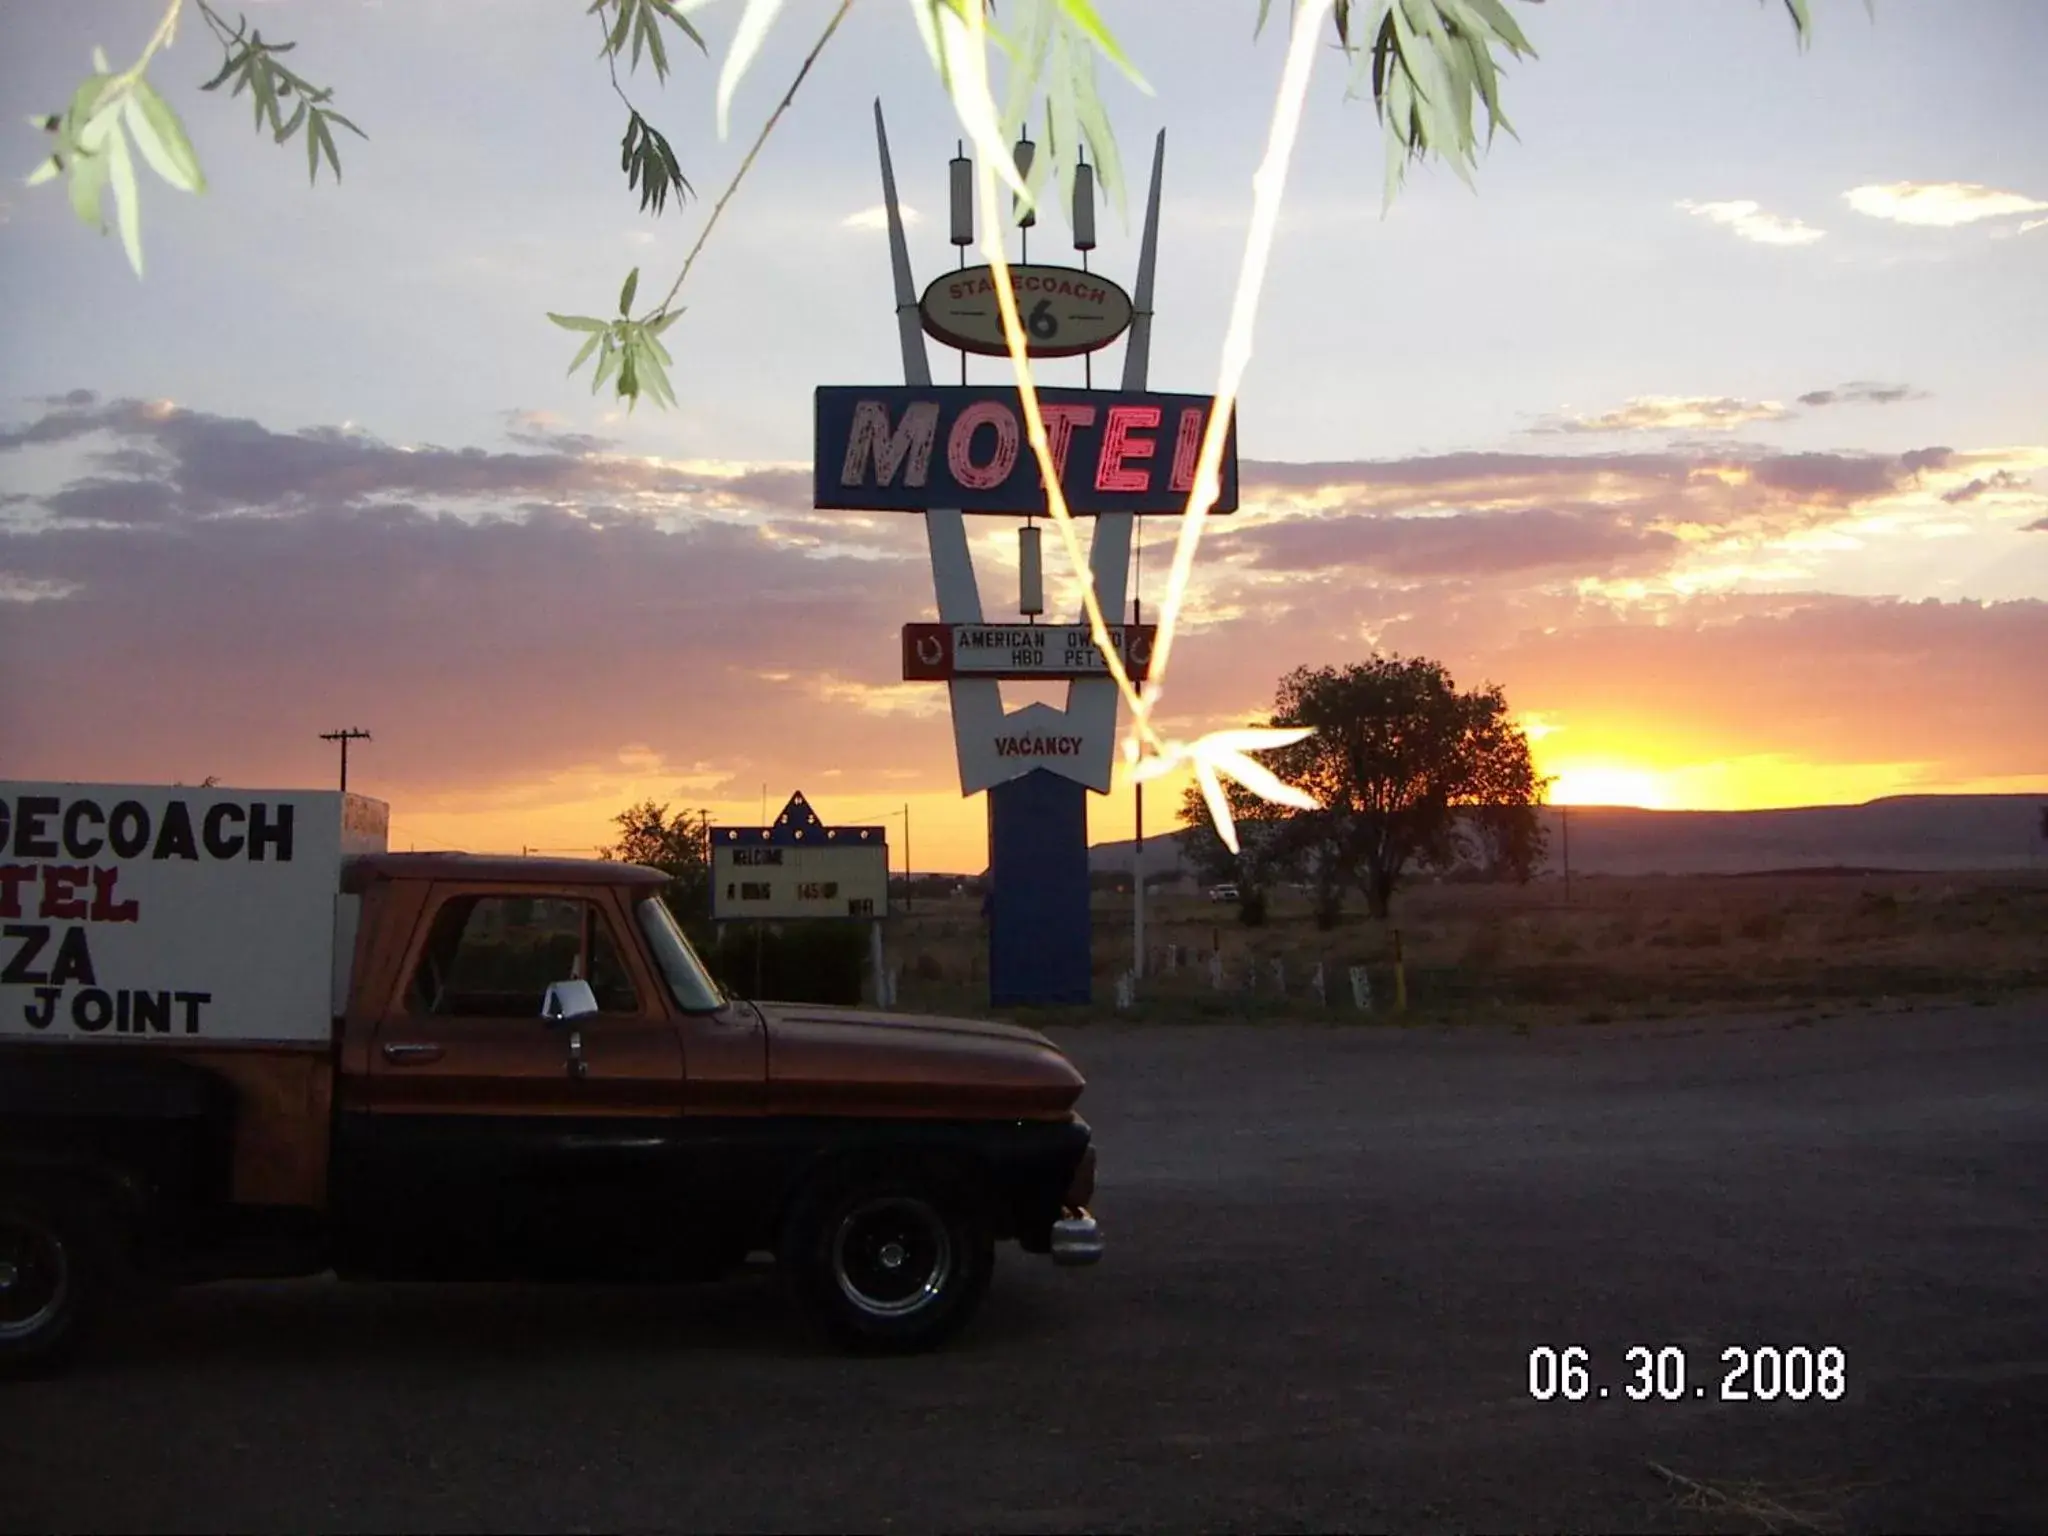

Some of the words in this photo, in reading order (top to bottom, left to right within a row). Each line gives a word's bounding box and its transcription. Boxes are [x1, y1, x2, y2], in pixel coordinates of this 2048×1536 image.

[949, 274, 1106, 306] STAECOACH
[958, 631, 1045, 648] AMERICAN
[1067, 632, 1122, 648] OWD
[995, 737, 1083, 756] VACANCY
[0, 796, 294, 861] ECOACH
[1, 925, 96, 985] ZA
[24, 987, 211, 1033] JOINT
